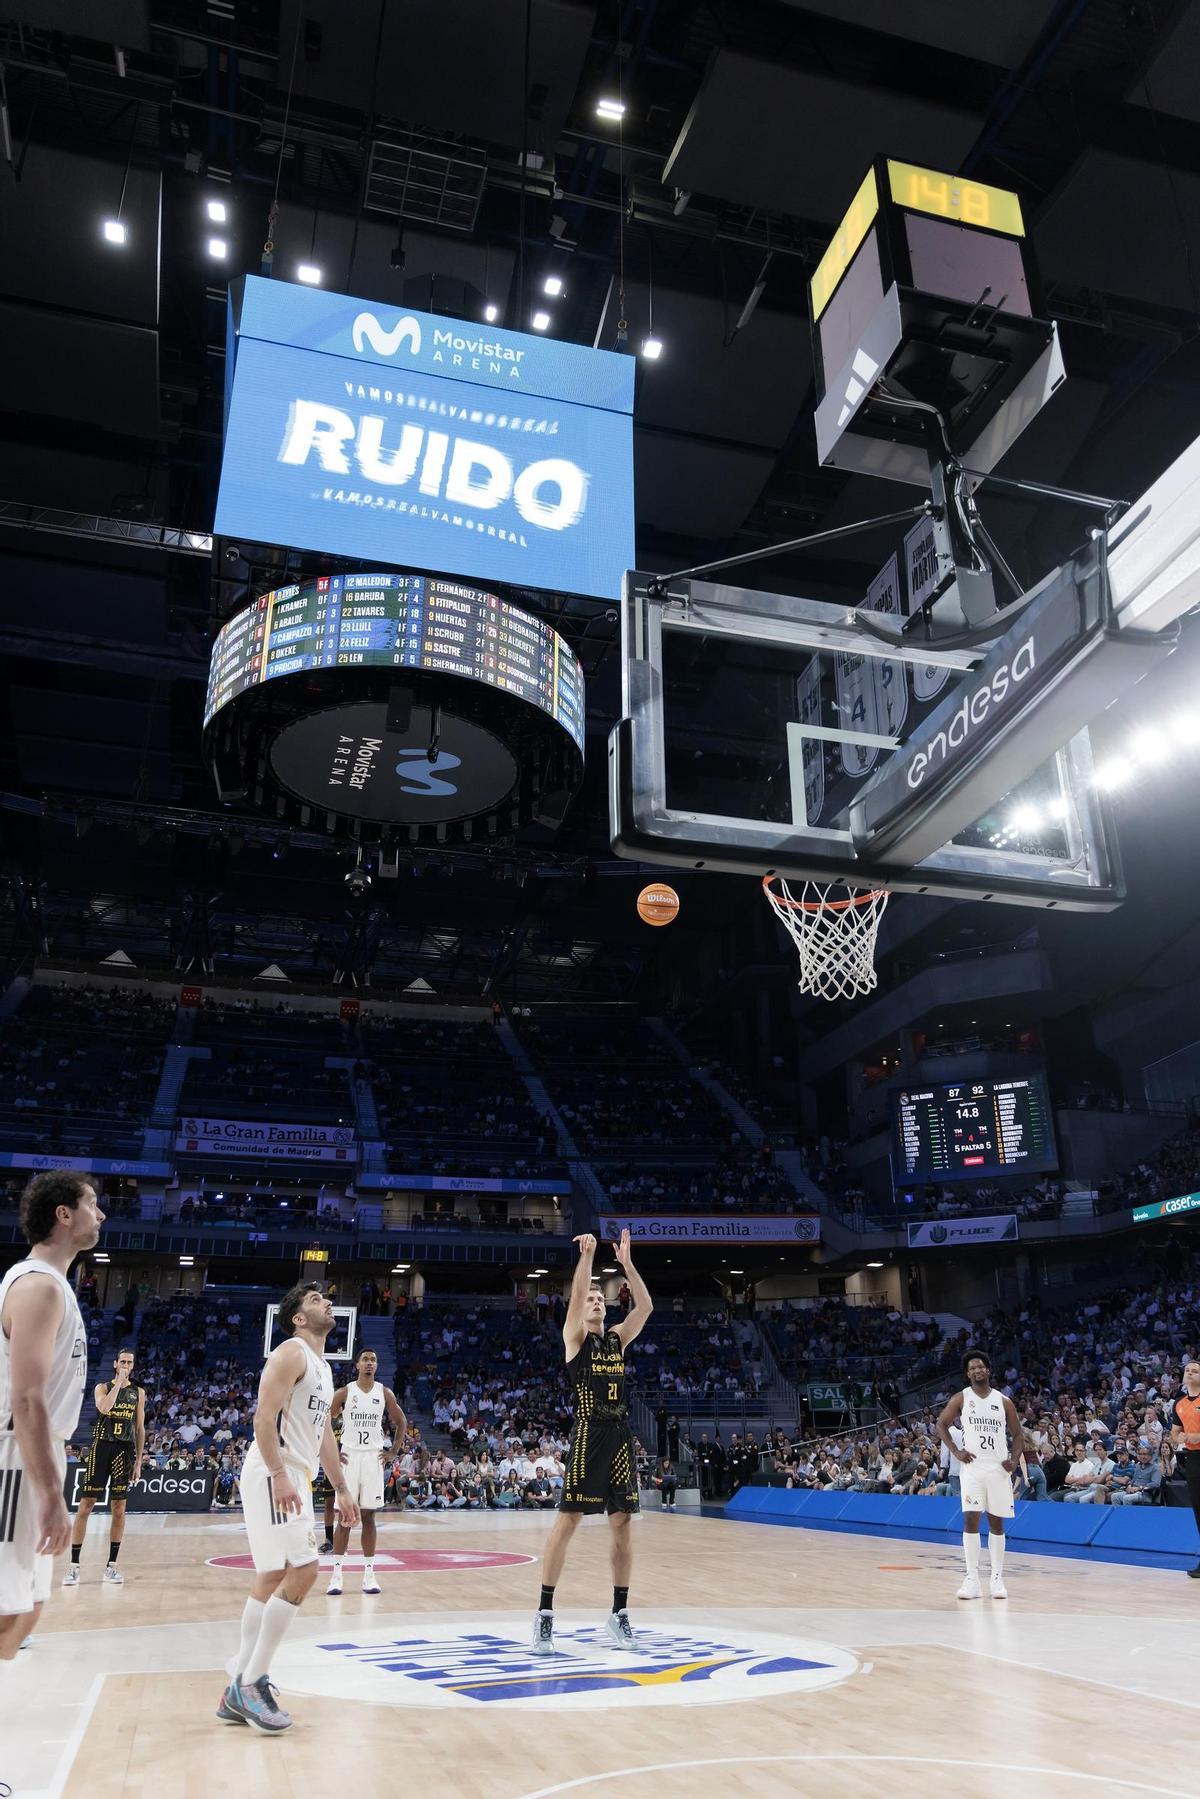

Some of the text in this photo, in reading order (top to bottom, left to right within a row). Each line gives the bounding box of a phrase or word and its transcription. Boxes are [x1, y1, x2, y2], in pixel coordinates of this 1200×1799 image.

[433, 329, 525, 362] Movistar
[433, 351, 520, 378] ARENA
[277, 399, 592, 532] RUIDO
[355, 577, 391, 586] MALEDON
[346, 593, 353, 601] 16
[354, 592, 384, 601] GARUBA
[414, 594, 419, 603] 4
[431, 582, 435, 590] 3
[437, 583, 475, 600] FERNÁNDEZ
[281, 598, 307, 614] KRAMER
[342, 608, 352, 616] 22
[353, 607, 384, 616] TAVARES
[502, 603, 509, 613] 21
[279, 614, 303, 628] ABALDE
[341, 623, 350, 631] 23
[352, 622, 371, 631] LLULL
[412, 624, 417, 633] 8
[435, 612, 467, 628] HUERTAS
[502, 617, 508, 627] 31
[277, 626, 312, 644] CAMPAZZO
[340, 639, 349, 647] 24
[351, 637, 369, 646] FELIZ
[409, 640, 417, 648] 15
[428, 627, 433, 635] 11
[434, 628, 464, 642] SCRUBB
[490, 642, 494, 652] 5
[425, 642, 432, 651] 15
[434, 643, 460, 657] SASTRE
[499, 631, 535, 656] 33 ALDERETE
[276, 645, 296, 658] OKEKE
[339, 654, 348, 663] 25
[350, 653, 363, 662] LEN
[410, 655, 415, 663] 5
[499, 647, 507, 657] 35
[507, 650, 531, 668] GUERRA
[274, 659, 302, 674] PROCIDA
[424, 657, 431, 666] 19
[432, 659, 472, 675] SHERMADINI
[498, 662, 506, 672] 42
[881, 661, 893, 689] 5
[506, 680, 523, 695] MILLS
[851, 693, 866, 723] 4
[907, 636, 1036, 788] endesa
[329, 735, 354, 785] ARENA
[349, 737, 382, 790] Movistar
[647, 894, 675, 904] Wilson
[949, 1085, 984, 1098] 87 92
[956, 1107, 979, 1119] 14.8
[203, 1121, 328, 1142] La Gran Familia
[213, 1142, 321, 1157] Comunidad de Madrid
[954, 1141, 992, 1153] 5 FALTAS 5
[630, 1222, 751, 1236] La Gran Familia
[949, 1226, 995, 1237] FLUGE
[608, 1383, 618, 1400] 21
[813, 1386, 872, 1400] SALA
[113, 1422, 123, 1435] 15
[969, 1416, 1002, 1427] Emirates
[358, 1431, 369, 1445] 12
[980, 1435, 995, 1450] 24
[129, 1474, 206, 1494] ndesa
